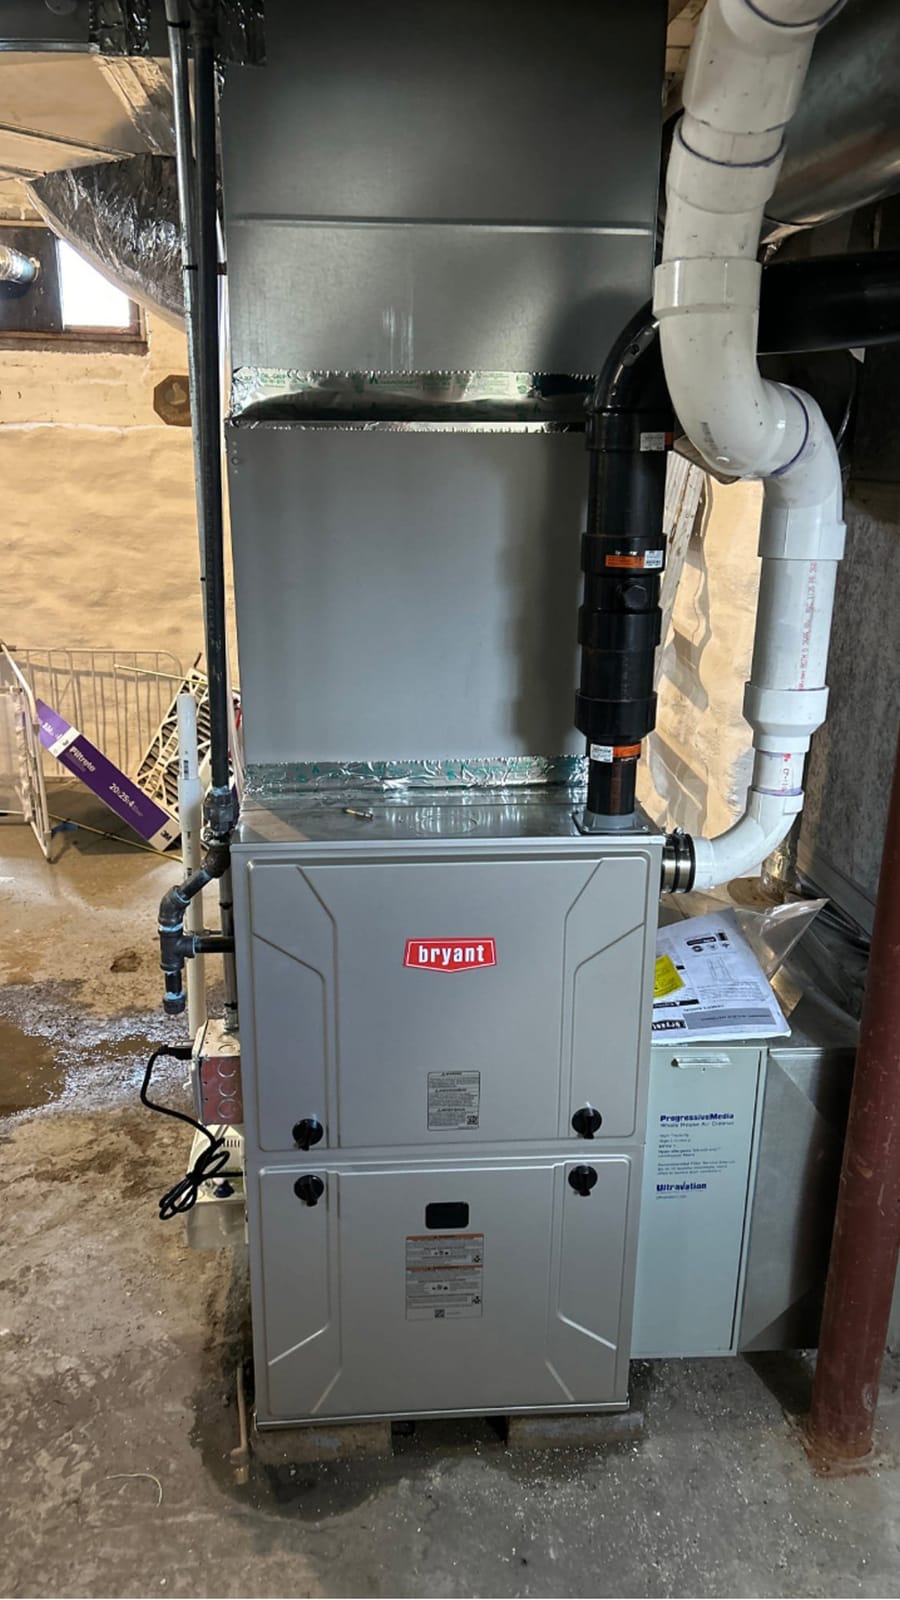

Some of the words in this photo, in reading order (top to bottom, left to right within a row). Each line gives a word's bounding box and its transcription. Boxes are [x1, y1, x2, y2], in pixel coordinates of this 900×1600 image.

[160, 830, 172, 842] 3M
[418, 944, 484, 966] bryant
[660, 1112, 734, 1122] ProgressiveMedia
